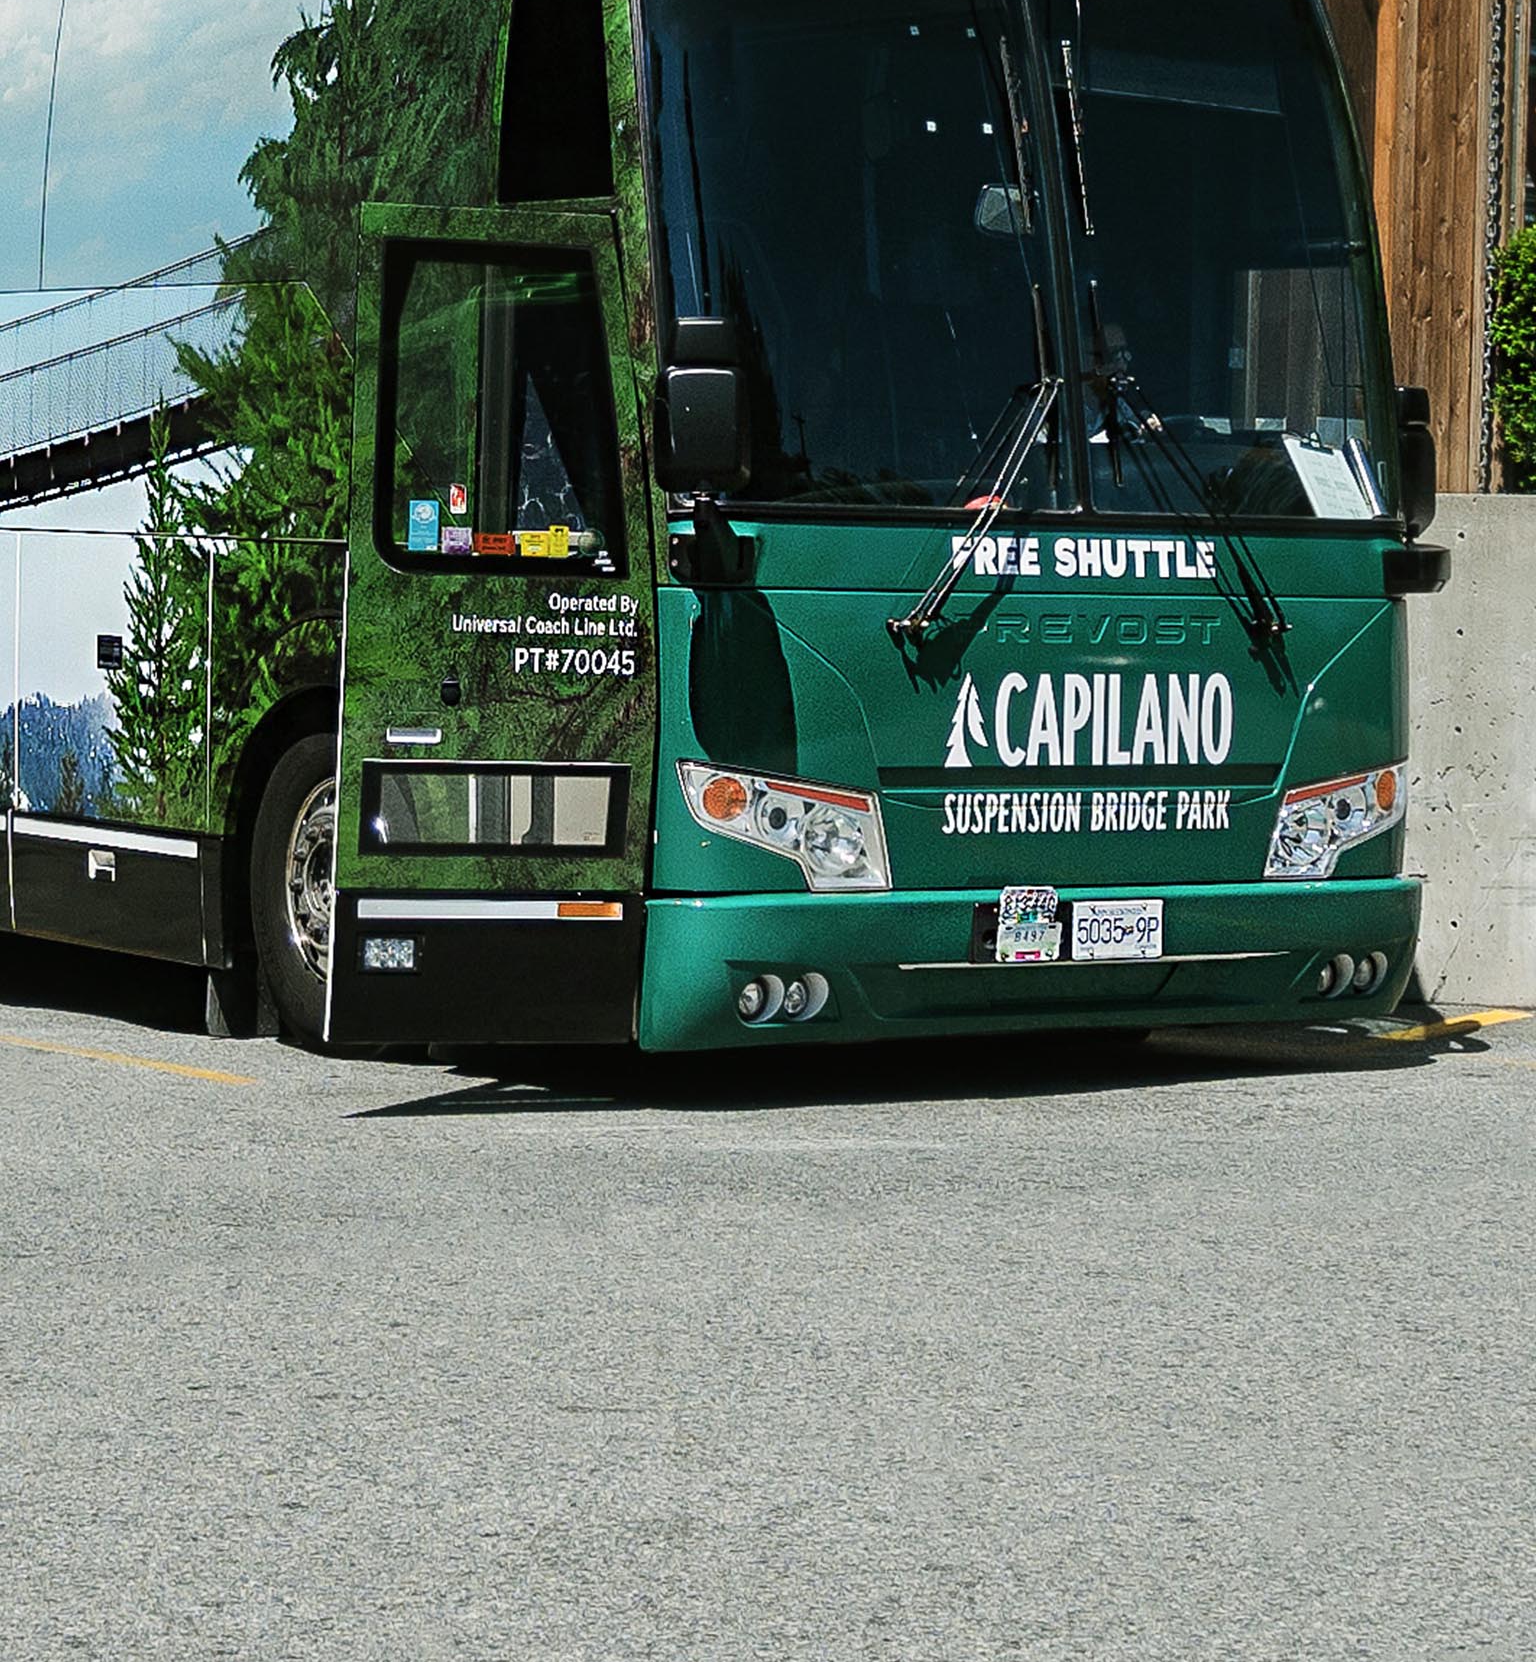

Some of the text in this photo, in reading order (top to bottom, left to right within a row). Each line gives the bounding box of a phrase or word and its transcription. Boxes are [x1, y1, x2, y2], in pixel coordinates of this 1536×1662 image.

[951, 536, 1217, 579] FREE SHUTTLE
[549, 592, 639, 617] Operated By
[452, 614, 638, 638] Universal Coach Line Ltd.
[514, 647, 636, 676] PT#70045
[994, 671, 1234, 768] CAPILANO
[941, 789, 1231, 835] SUSPENSION BRIDGE PARK
